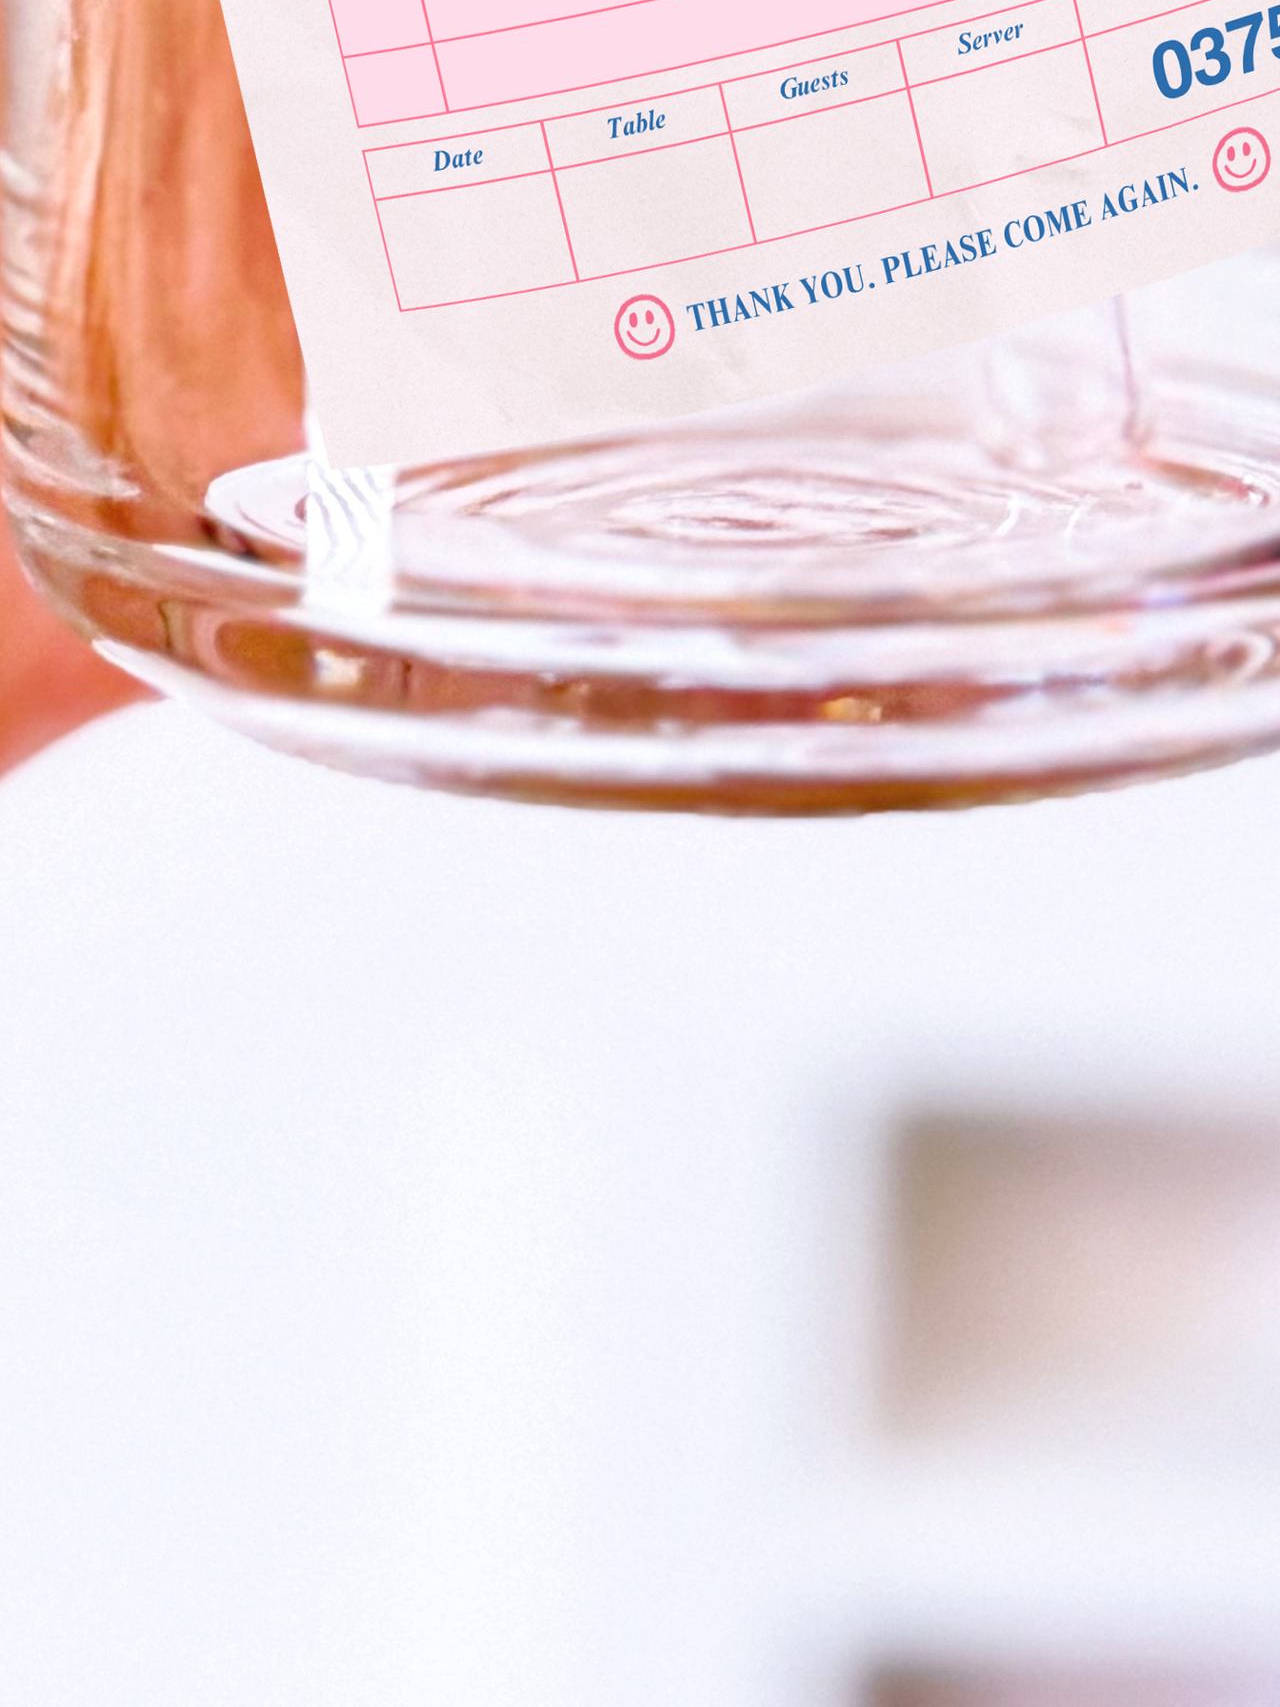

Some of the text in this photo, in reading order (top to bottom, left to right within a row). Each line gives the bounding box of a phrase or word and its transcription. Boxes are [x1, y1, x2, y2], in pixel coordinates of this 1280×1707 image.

[956, 22, 1025, 57] Server
[778, 69, 850, 101] Guests
[606, 108, 667, 141] Table
[432, 148, 485, 173] Date
[684, 166, 1200, 333] THANK YOU. PLEASE COME AGAIN.
